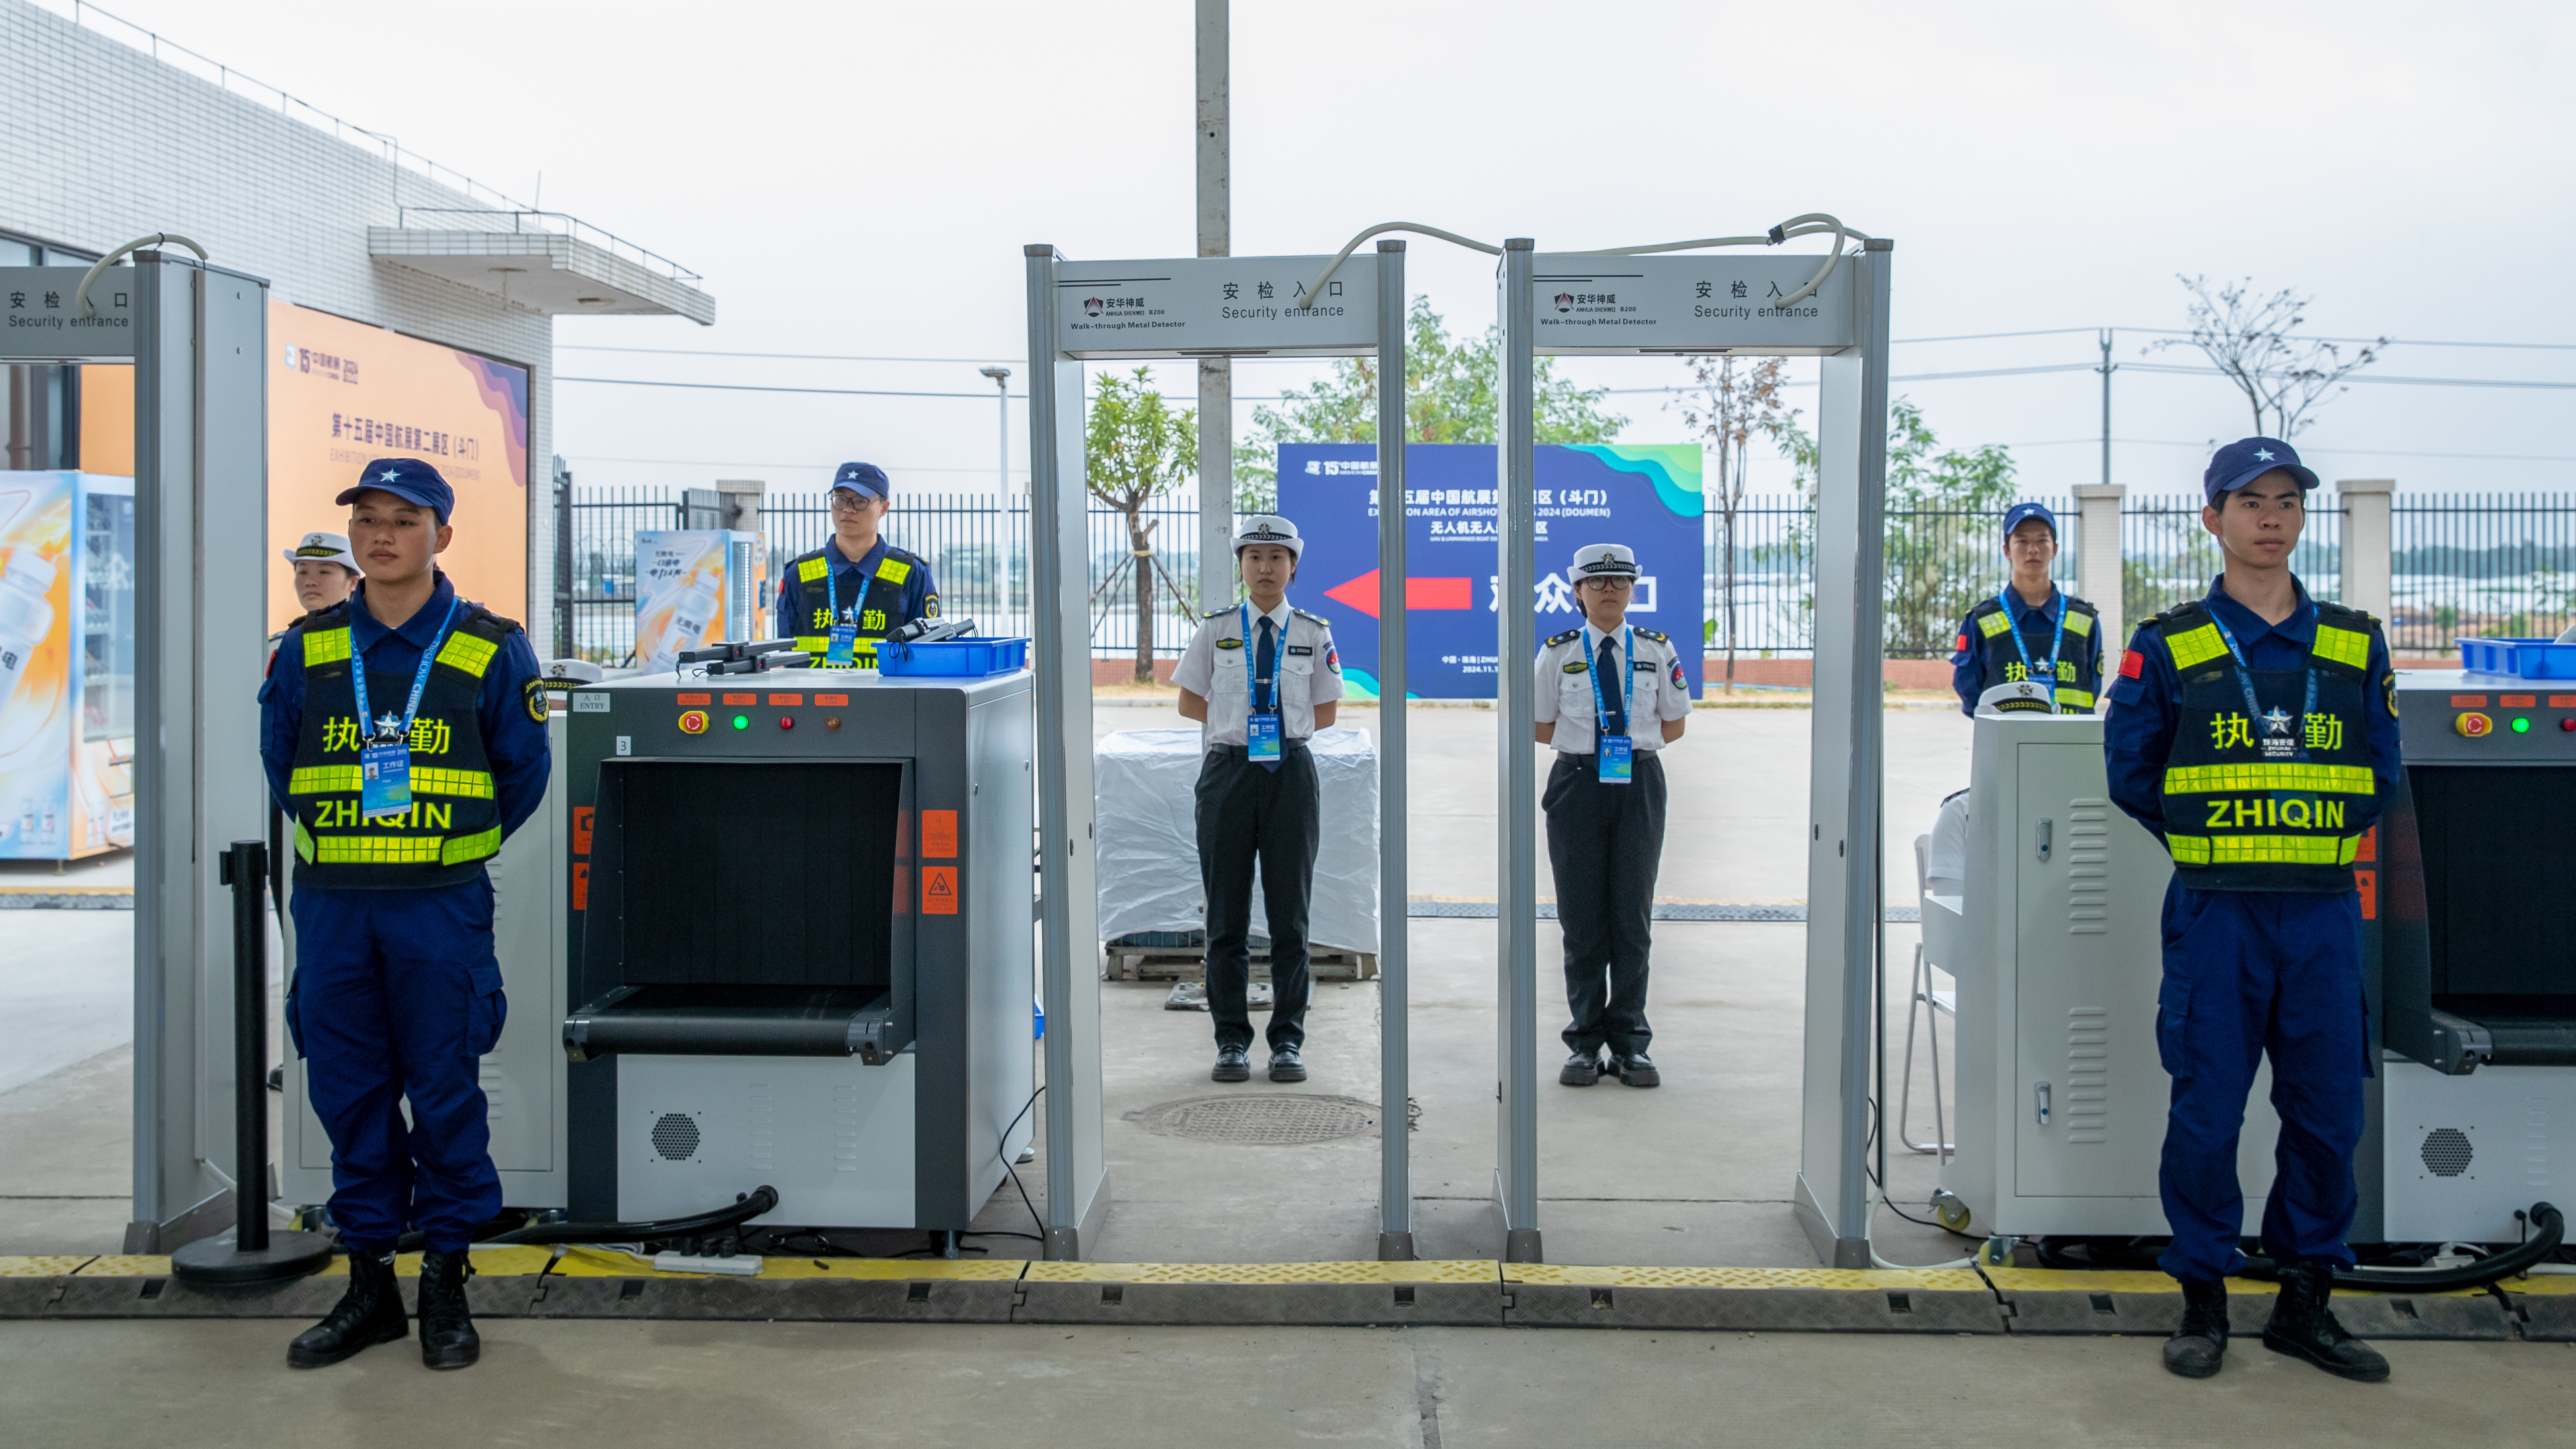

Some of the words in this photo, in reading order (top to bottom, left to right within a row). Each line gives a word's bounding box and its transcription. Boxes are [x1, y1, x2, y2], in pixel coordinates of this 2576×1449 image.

[1223, 281, 1342, 300] 安检入口
[10, 291, 127, 309] 安检口
[1106, 297, 1144, 308] 安华神威
[1577, 294, 1616, 304] 安华神威
[1222, 306, 1277, 320] Security
[1285, 306, 1344, 317] entrance
[1694, 305, 1750, 320] Security
[1758, 306, 1818, 317] entrance
[9, 315, 63, 330] Security
[70, 316, 128, 327] entrance
[1323, 461, 1339, 475] 15
[1422, 508, 1447, 516] AREA
[1448, 508, 1461, 516] OF
[1537, 508, 1560, 516] 2024
[1562, 507, 1611, 518] (DOUMEN)
[813, 608, 886, 630] 执勤
[2004, 661, 2076, 683] 执勤
[405, 683, 422, 715] CHINA
[323, 717, 451, 754] 执勤
[2210, 712, 2343, 750] 执勤
[620, 741, 627, 751] 3
[2206, 798, 2345, 829] ZHIQIN
